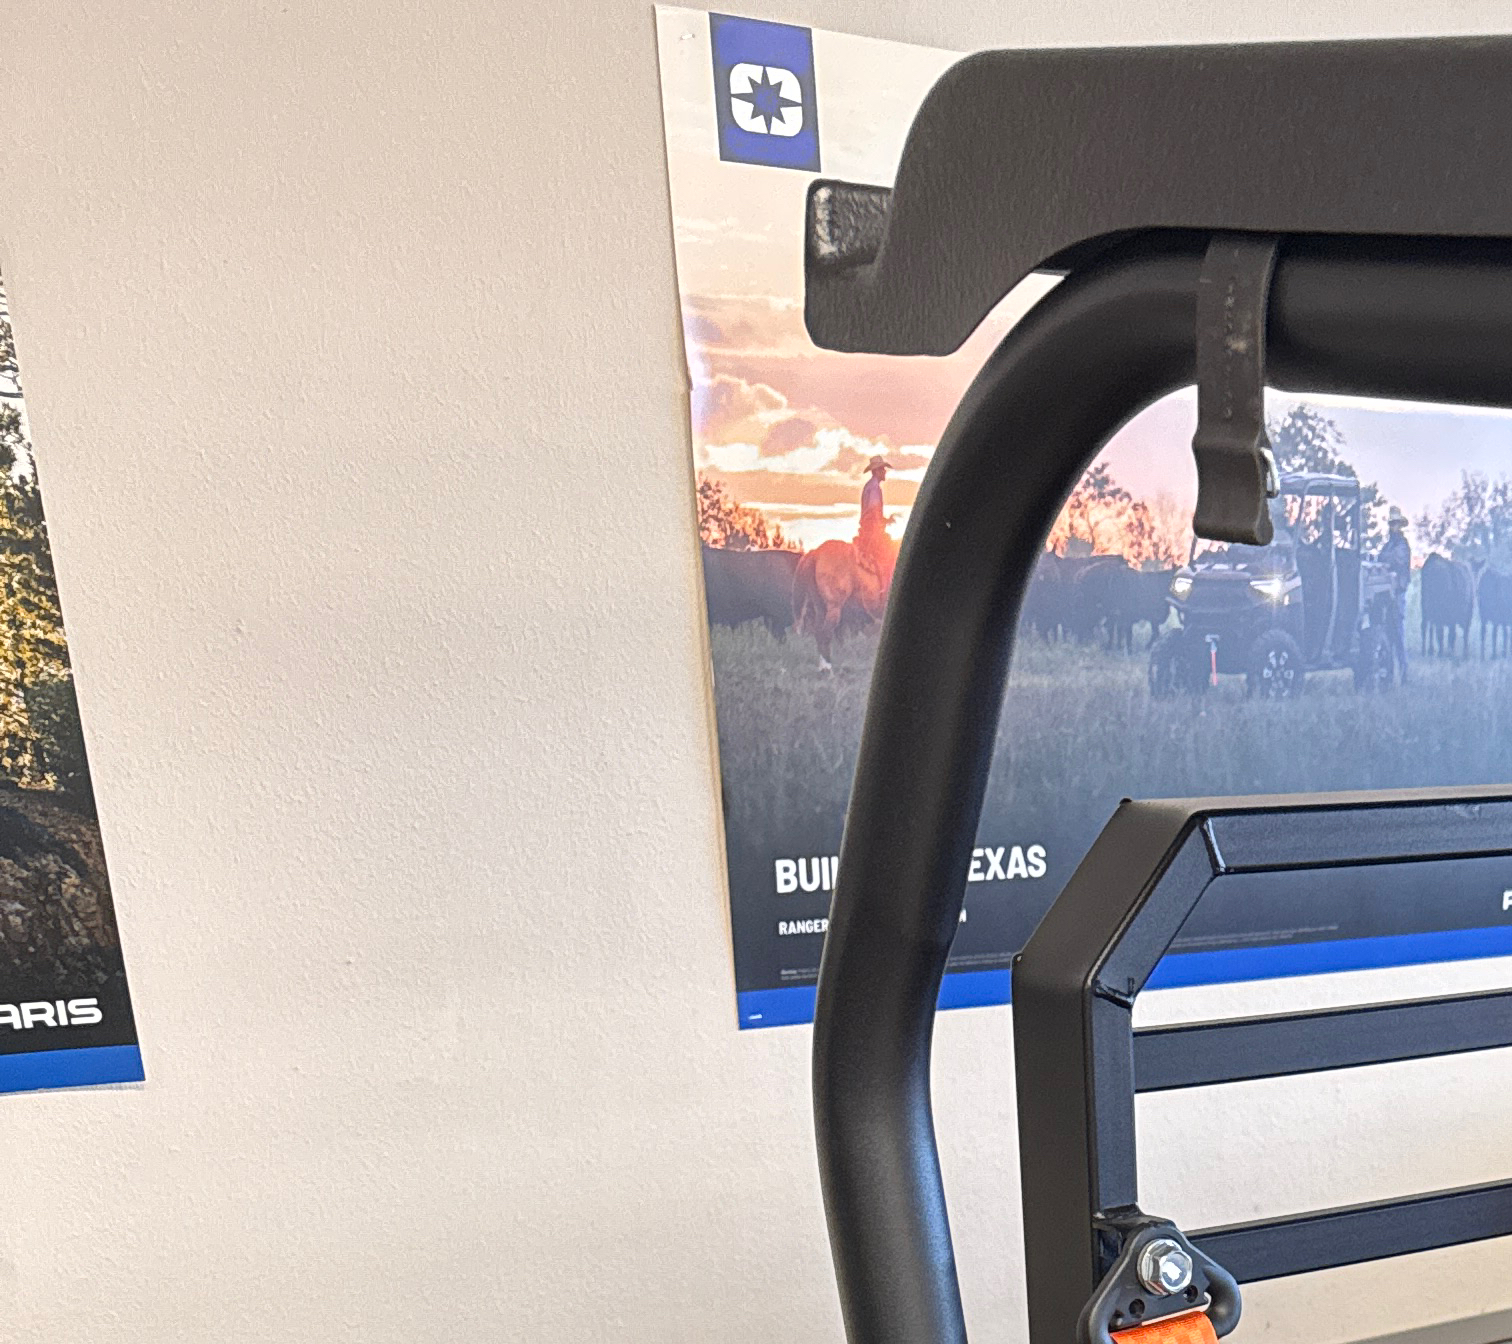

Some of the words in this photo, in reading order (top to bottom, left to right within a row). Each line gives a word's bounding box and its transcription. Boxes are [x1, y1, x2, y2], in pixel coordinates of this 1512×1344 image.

[967, 844, 1047, 882] EXAS
[778, 918, 829, 936] RANGER
[0, 997, 103, 1030] ARIS
